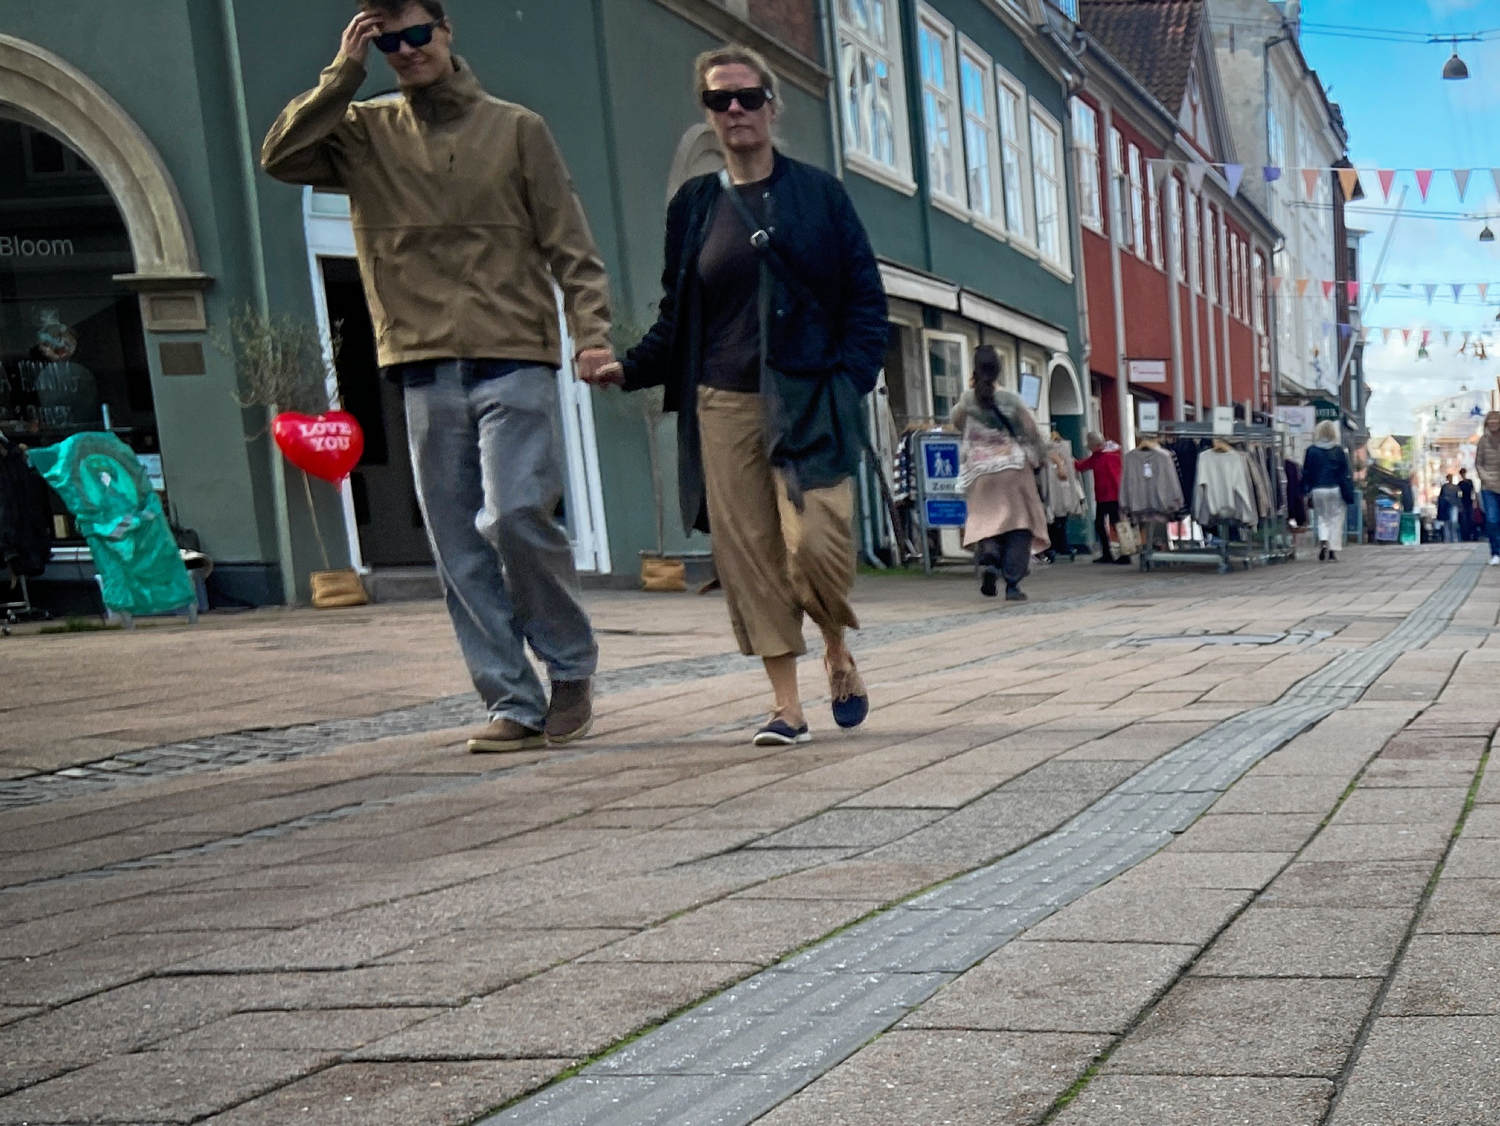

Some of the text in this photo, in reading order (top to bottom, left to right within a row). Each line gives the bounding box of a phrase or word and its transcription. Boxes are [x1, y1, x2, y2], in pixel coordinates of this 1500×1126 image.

[0, 236, 74, 256] Bloom
[299, 422, 351, 437] LOVE
[310, 436, 350, 452] YOU
